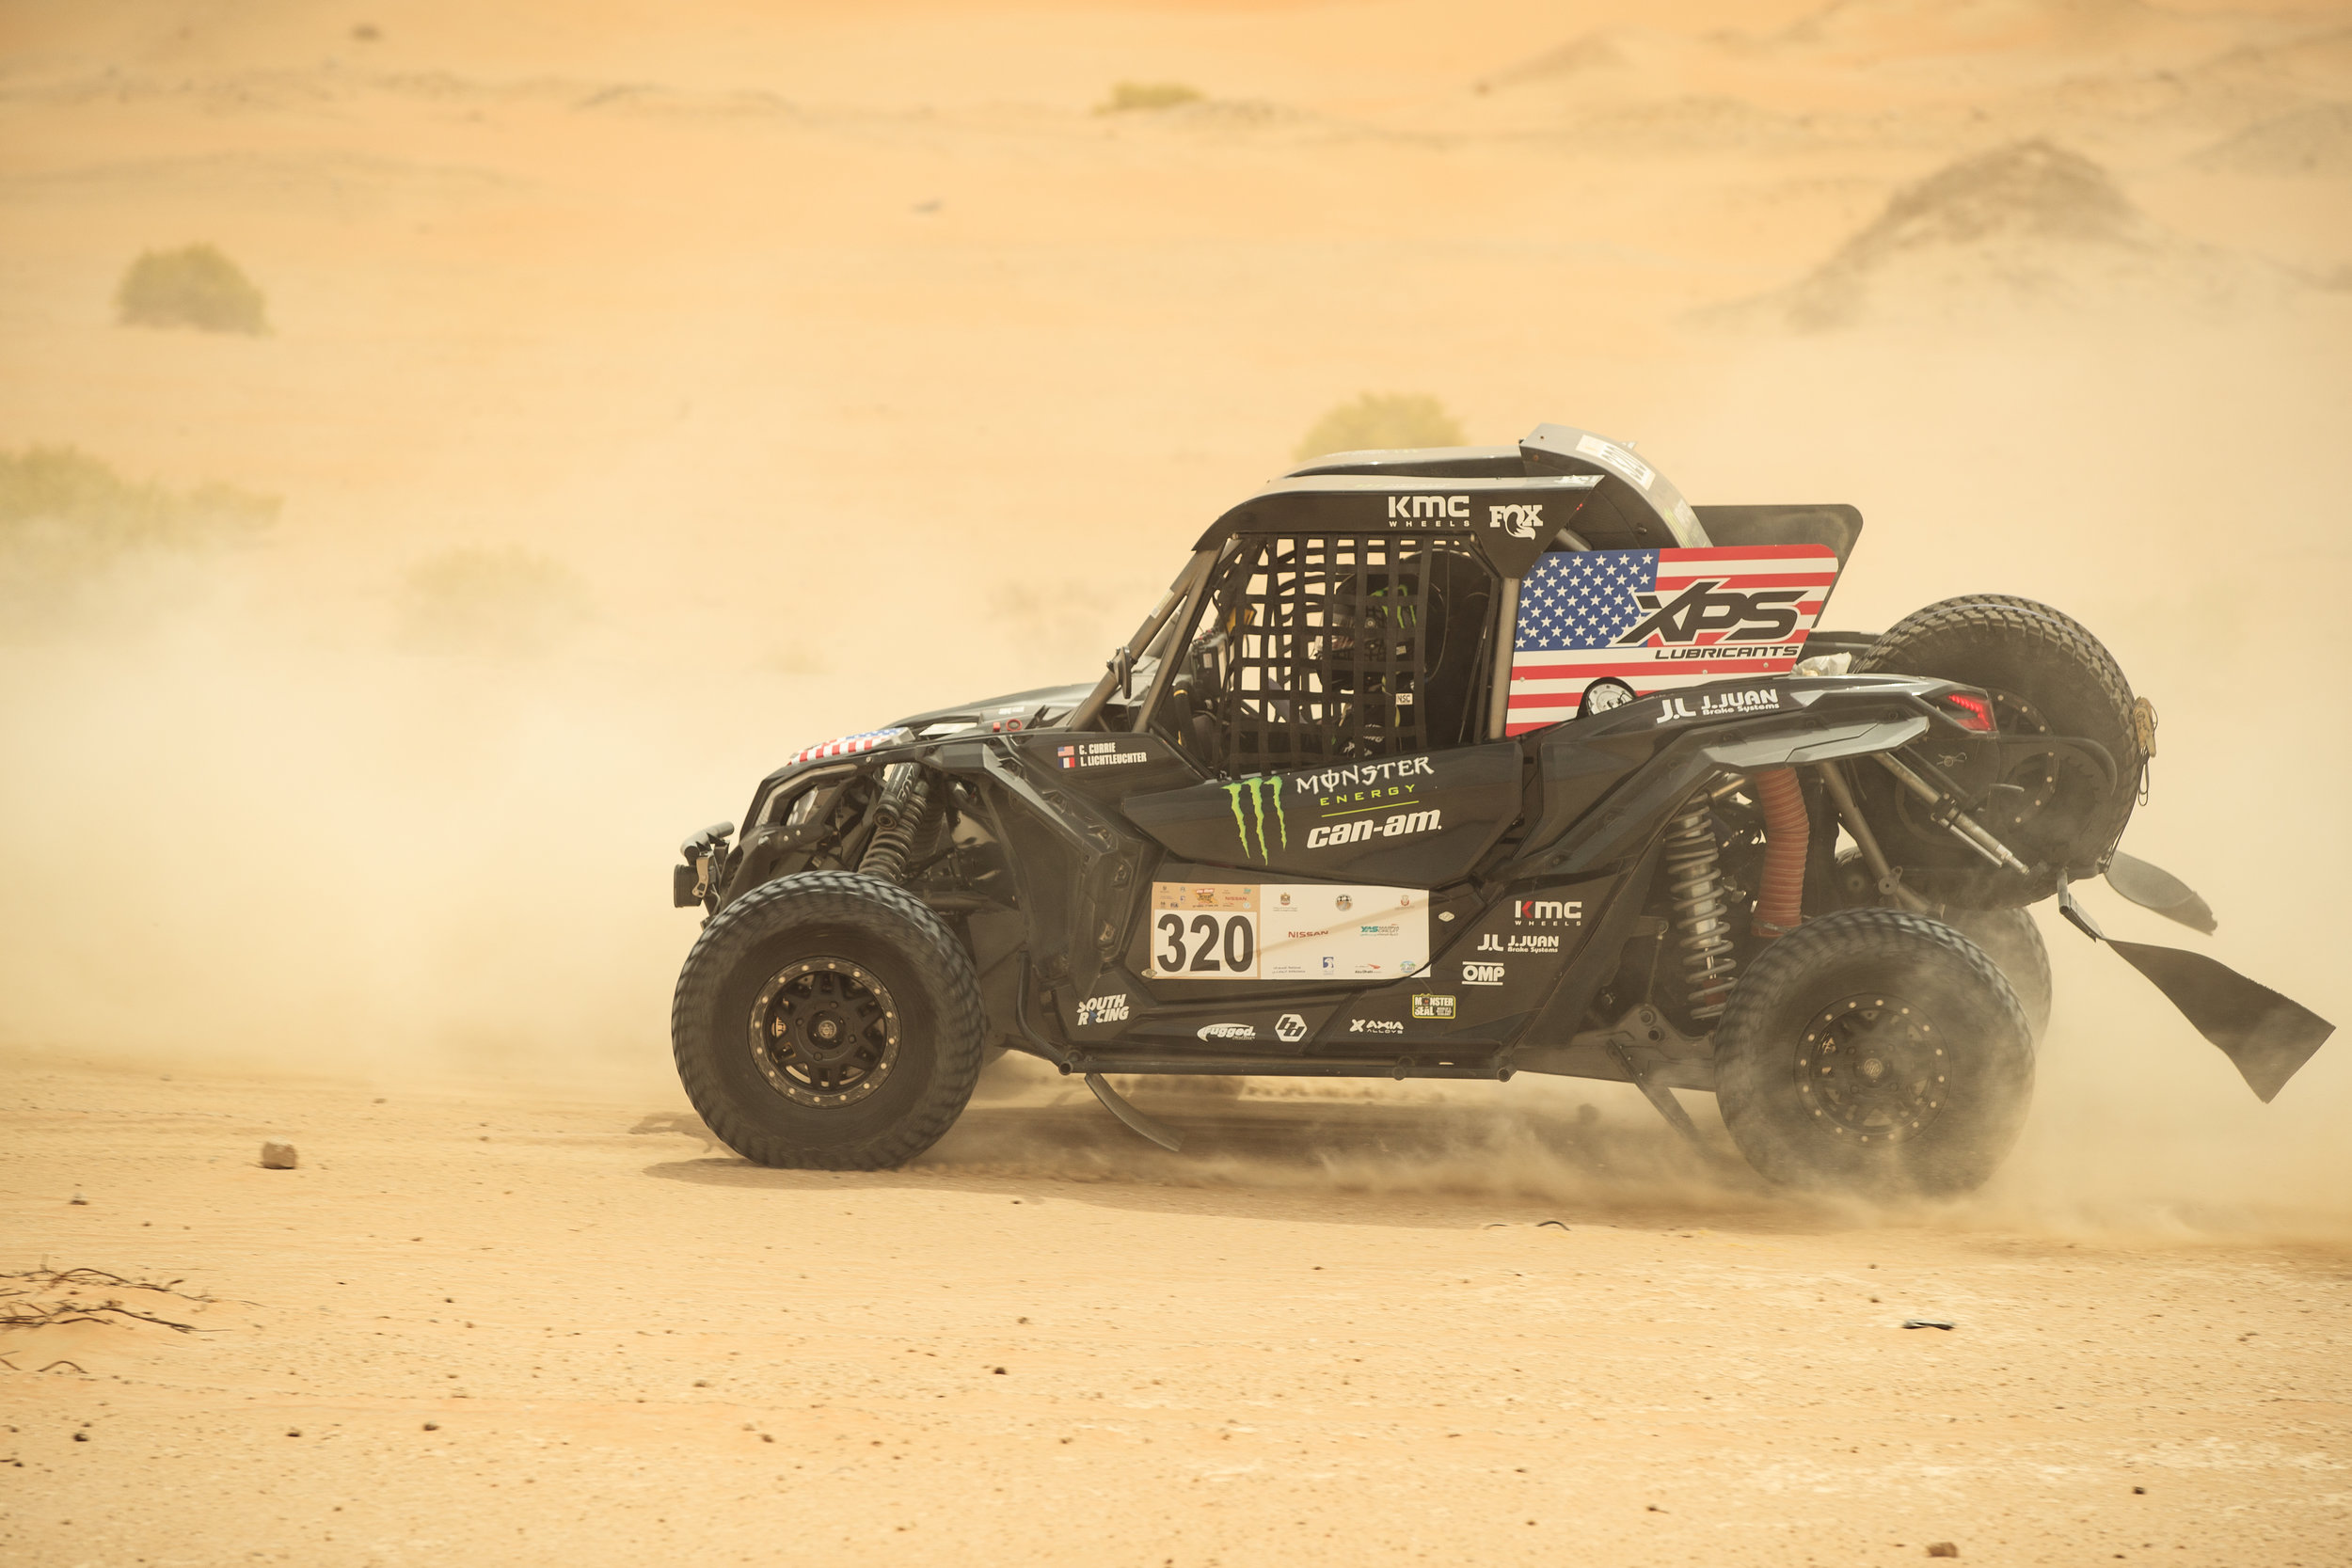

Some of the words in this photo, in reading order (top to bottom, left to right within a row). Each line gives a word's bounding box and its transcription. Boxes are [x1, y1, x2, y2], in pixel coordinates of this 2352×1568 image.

[1388, 495, 1470, 518] KMC
[1488, 503, 1544, 541] FOX
[1613, 579, 1810, 645] XPS
[1654, 645, 1800, 660] LUBRICANTS
[1701, 689, 1779, 710] J.JUAN
[1702, 706, 1735, 716] Brake
[1737, 703, 1780, 714] Systems
[1078, 744, 1088, 755] C.
[1089, 742, 1116, 754] CURRIE
[1080, 755, 1088, 768] L.
[1088, 752, 1147, 767] LICHTLEUCHTER
[1319, 784, 1416, 806] ENERGY
[1514, 900, 1582, 919] KMC
[1157, 913, 1254, 973] 320
[1507, 935, 1559, 948] J.JUAN
[1462, 965, 1505, 982] OMP
[1076, 993, 1127, 1014] SOUTH
[1414, 1006, 1435, 1016] SEAL
[1366, 1020, 1405, 1030] AXIA
